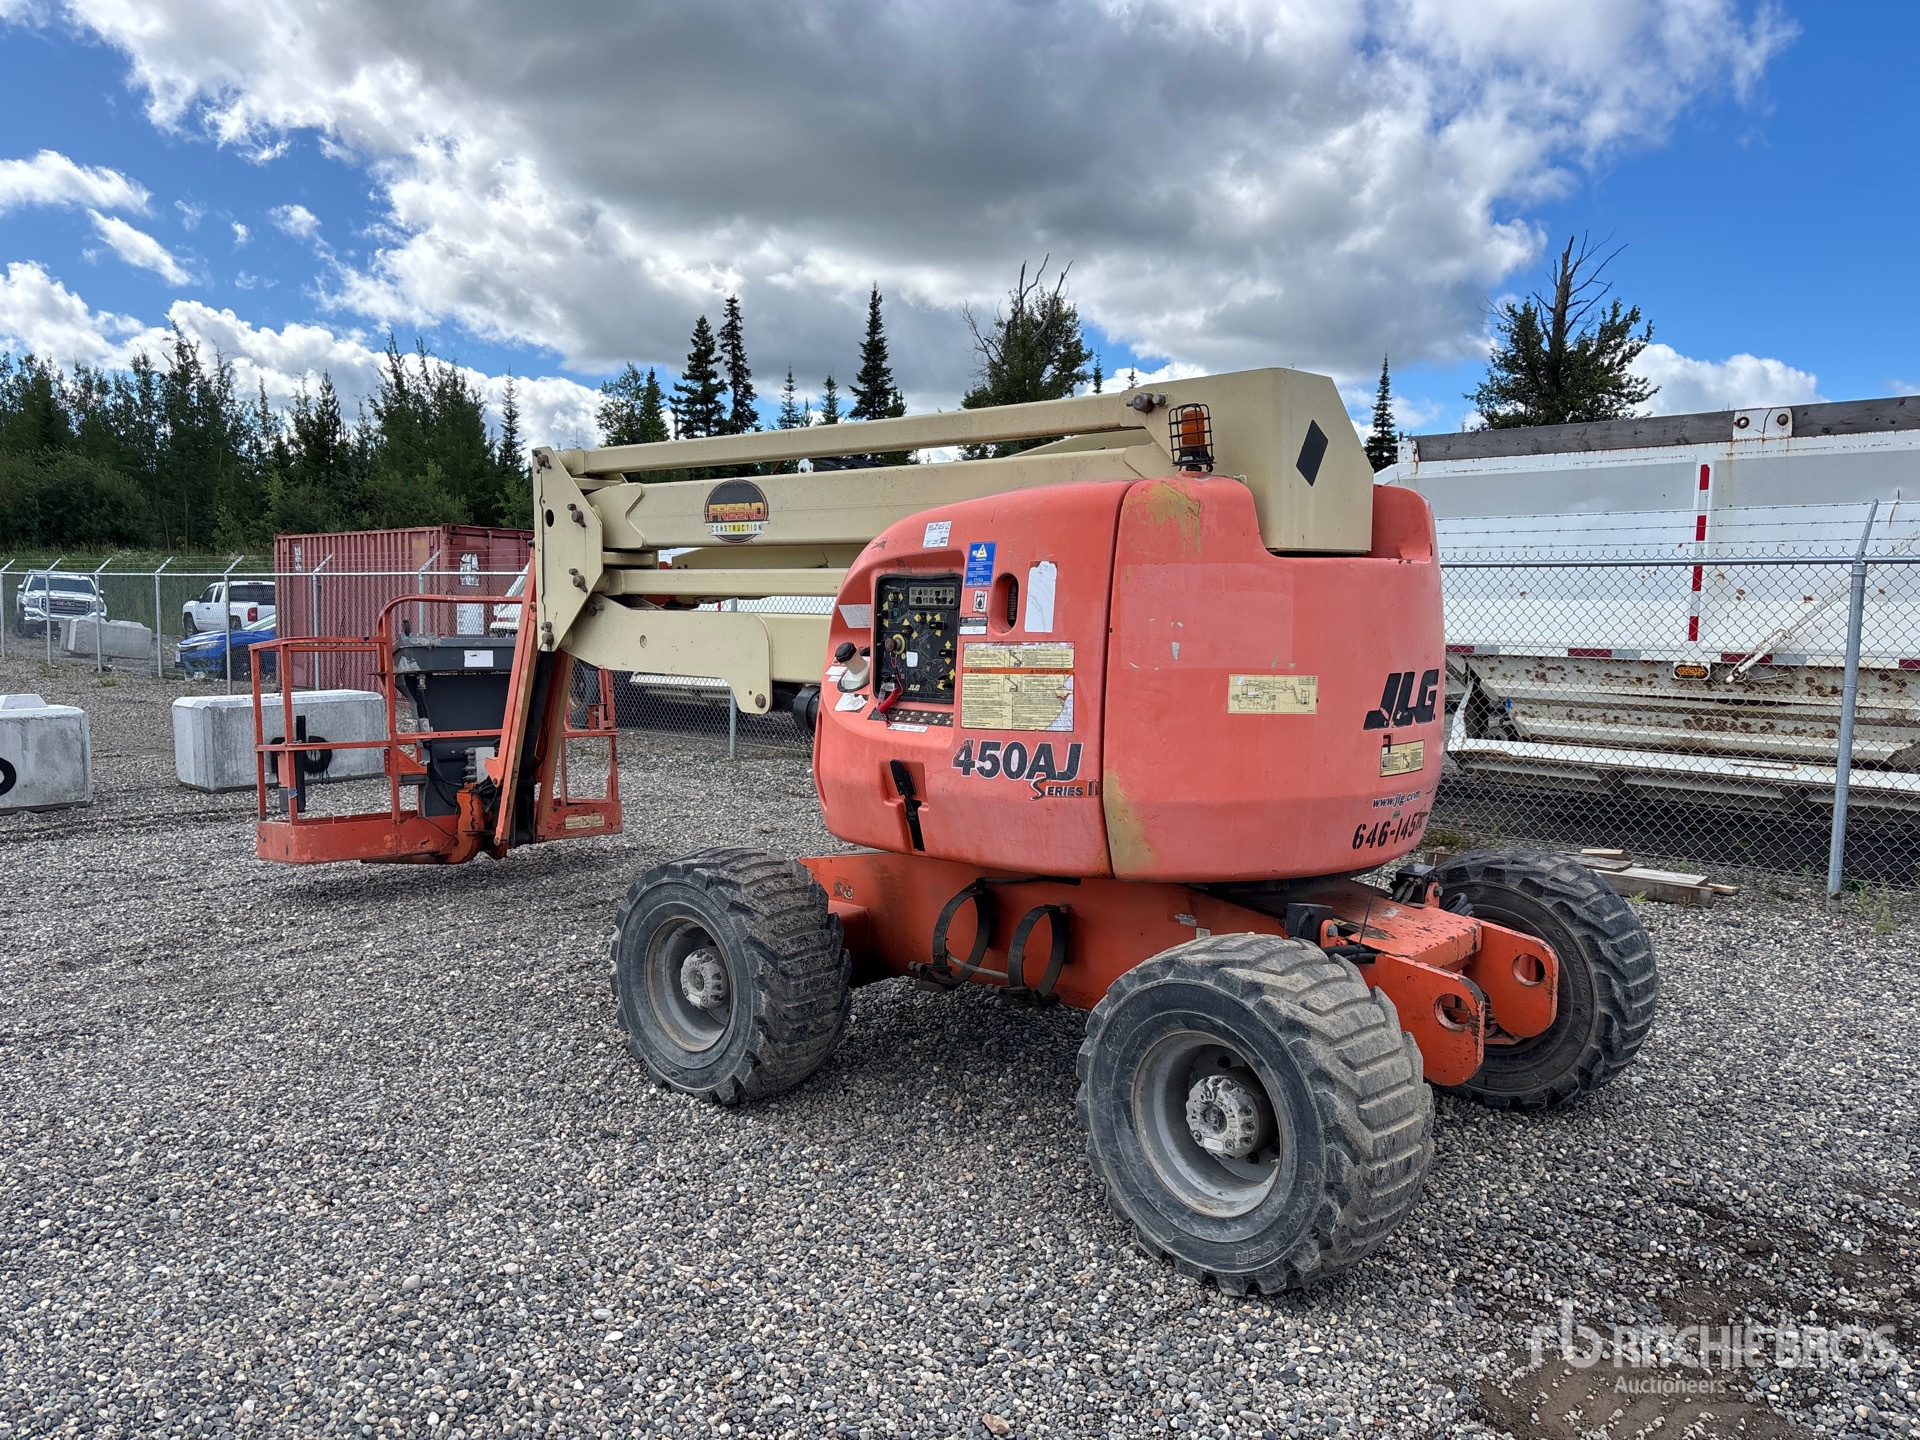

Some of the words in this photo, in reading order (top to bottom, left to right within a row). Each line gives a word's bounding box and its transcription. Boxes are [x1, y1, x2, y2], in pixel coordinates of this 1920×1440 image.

[708, 502, 765, 522] FRESNO
[711, 524, 762, 533] CONSTRUCTION
[1362, 668, 1440, 730] JLG
[952, 738, 1084, 782] 450AJ
